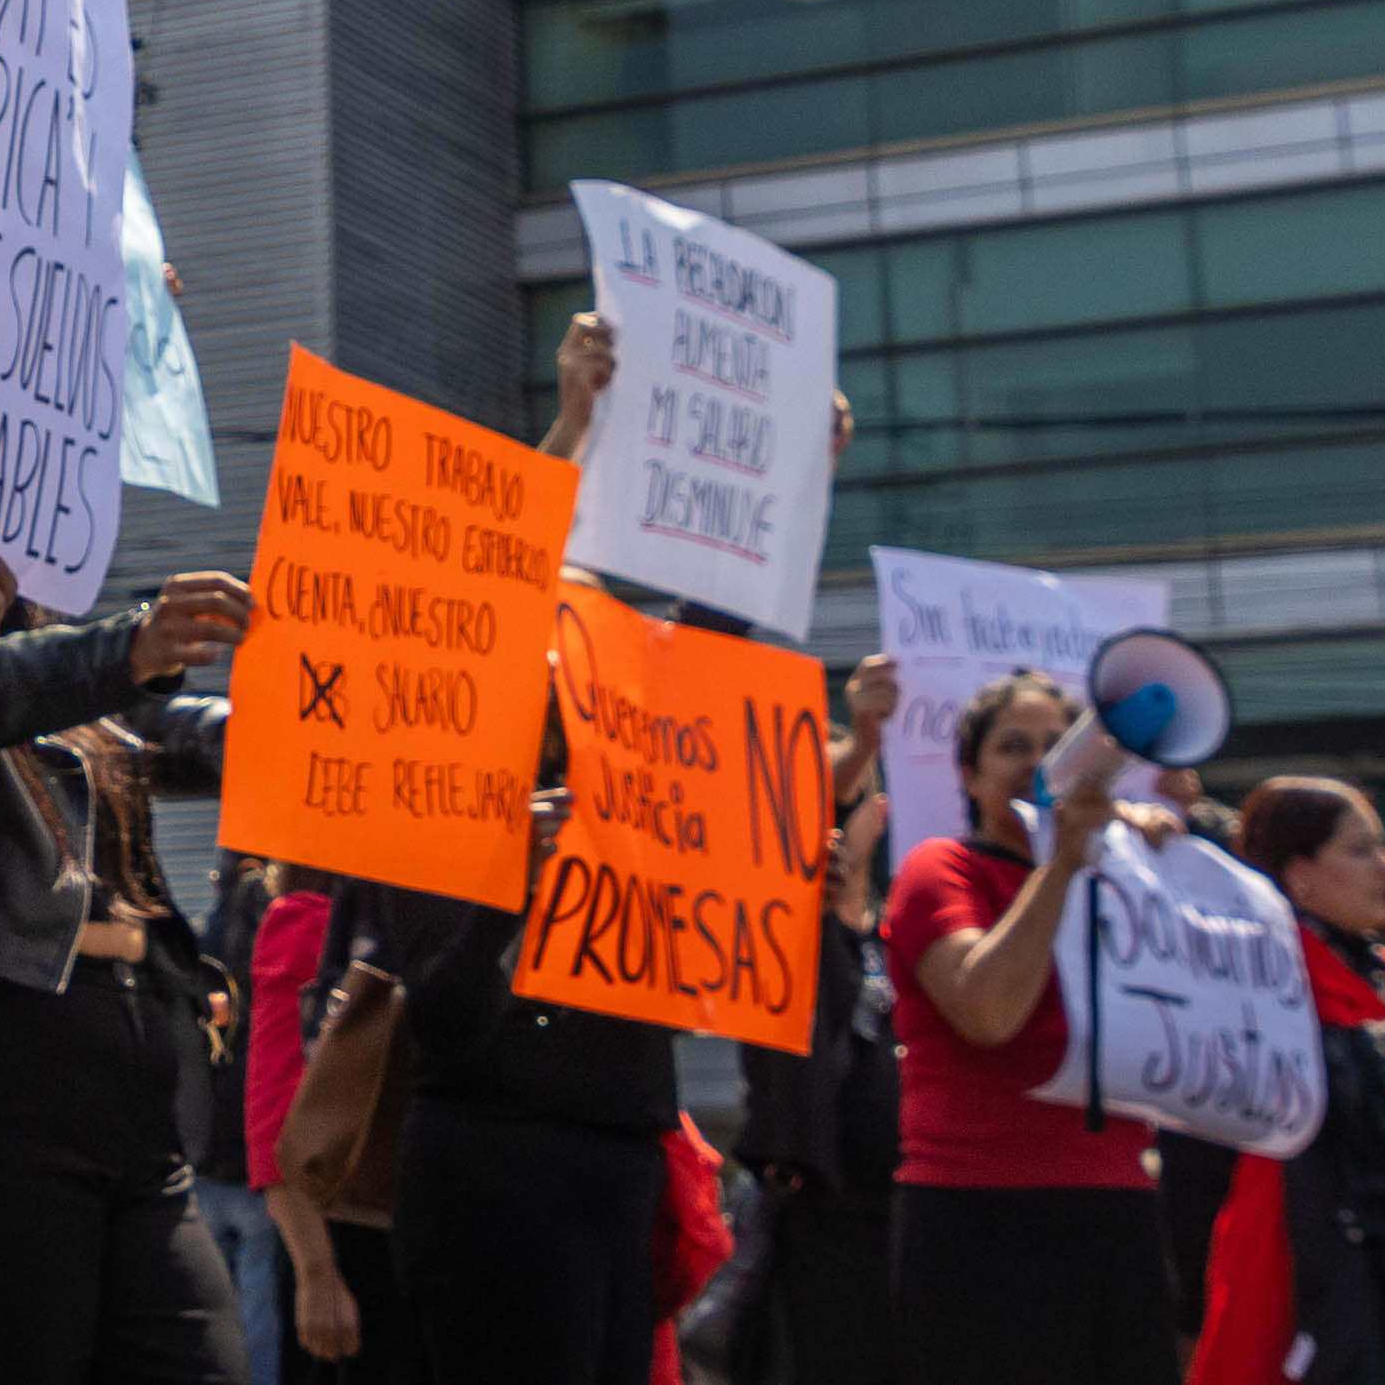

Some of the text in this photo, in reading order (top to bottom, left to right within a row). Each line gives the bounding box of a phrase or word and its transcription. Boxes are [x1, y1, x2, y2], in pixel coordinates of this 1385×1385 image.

[8, 247, 120, 442] SUELDOS
[282, 386, 525, 523] NUESTRO TRABAJO
[646, 383, 677, 444] MI
[349, 489, 452, 563] NUESTRO
[372, 662, 478, 736] SALARIO
[303, 751, 372, 817] DEBE
[743, 695, 829, 882] NO
[532, 855, 795, 1015] PROMESAS
